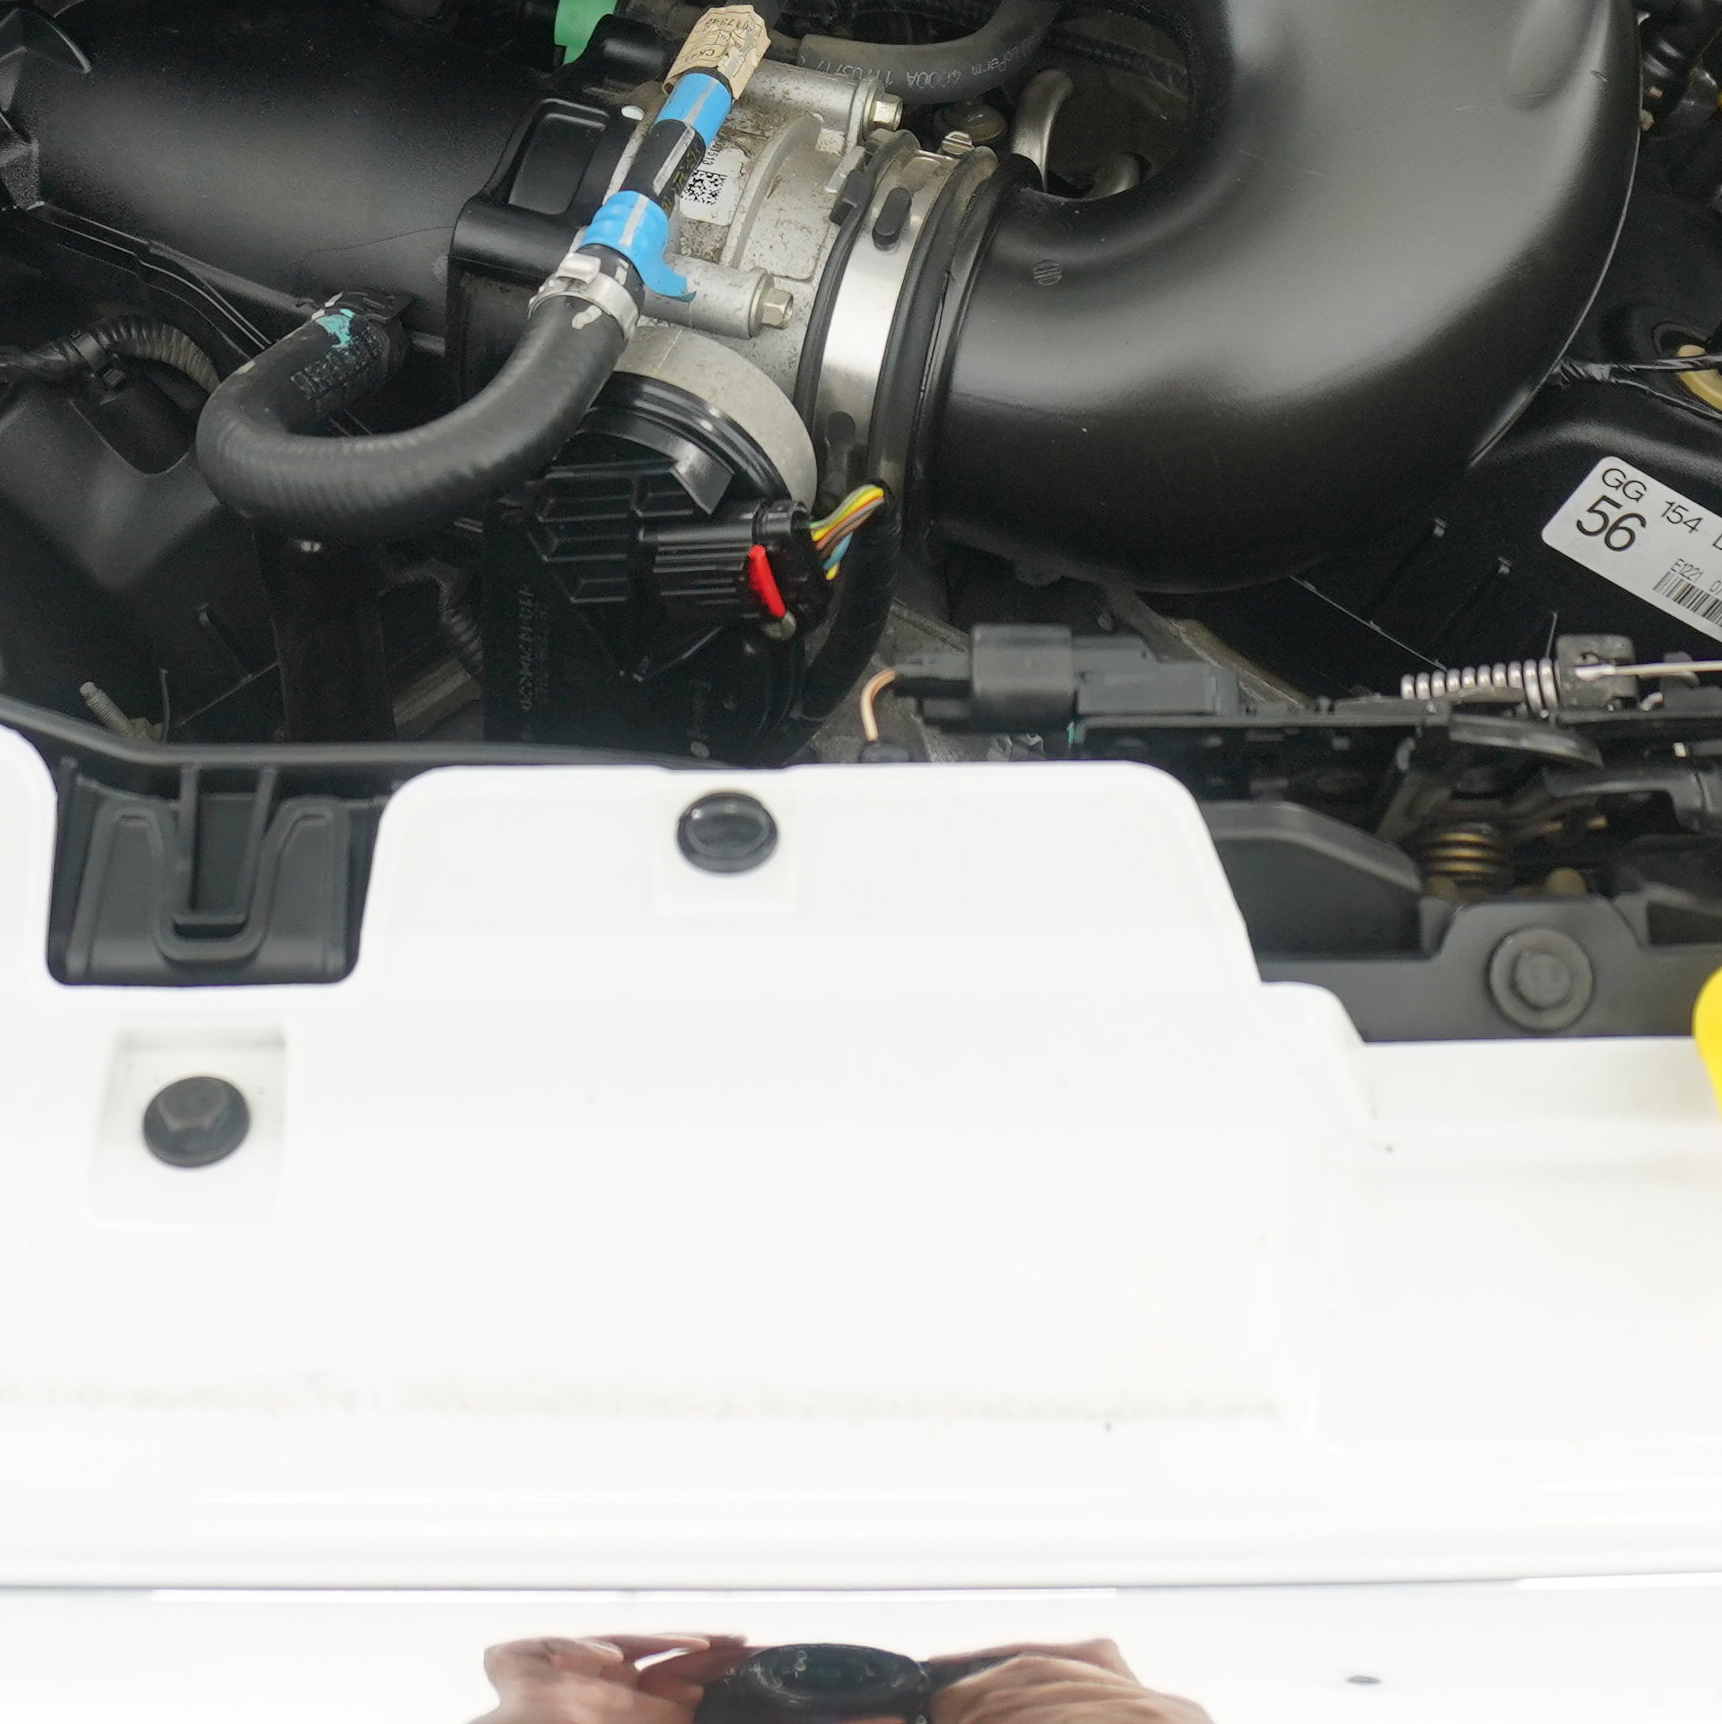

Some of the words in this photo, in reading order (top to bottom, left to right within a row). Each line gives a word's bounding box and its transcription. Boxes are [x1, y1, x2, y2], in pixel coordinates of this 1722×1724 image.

[1576, 494, 1647, 552] 56
[1601, 467, 1647, 503] GG
[1661, 500, 1704, 534] 154
[1670, 558, 1704, 583] E1221
